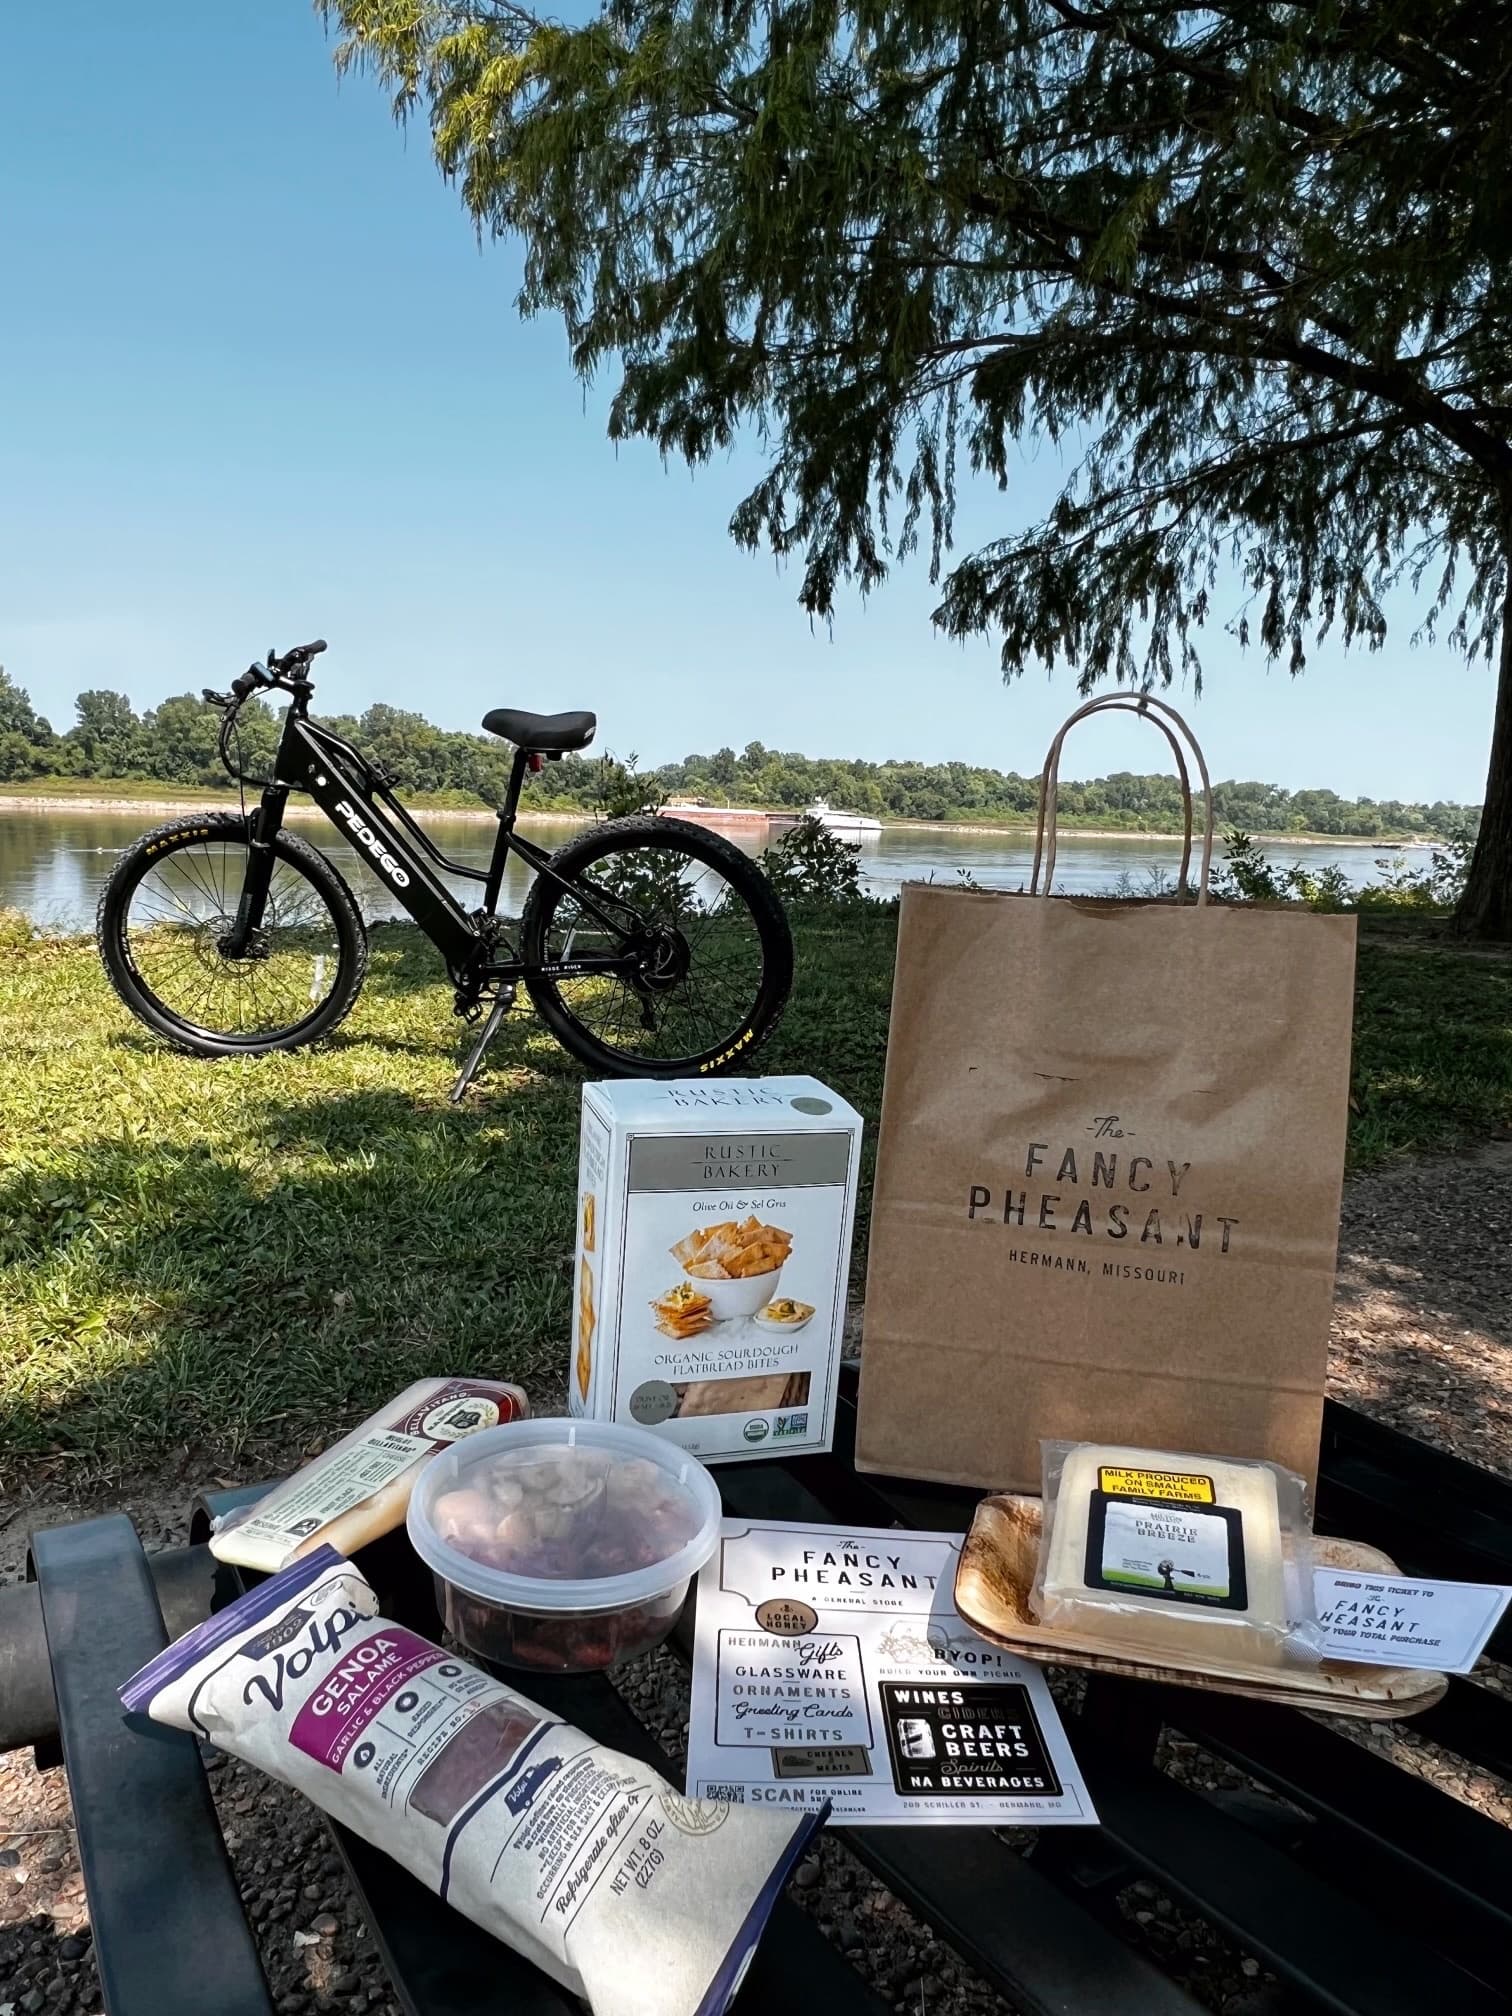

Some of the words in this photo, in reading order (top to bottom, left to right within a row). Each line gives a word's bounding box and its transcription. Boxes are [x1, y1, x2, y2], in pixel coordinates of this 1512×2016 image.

[145, 829, 209, 856] MAXXIS
[334, 800, 410, 888] PEDEGO
[700, 1028, 754, 1073] MAXXIS
[668, 1087, 777, 1097] RUSTIC
[674, 1097, 784, 1107] BAKERY
[1094, 1115, 1124, 1138] The
[705, 1144, 781, 1160] RUSTIC
[703, 1163, 780, 1179] BAKERY
[1025, 1143, 1191, 1197] FANCY
[692, 1201, 717, 1212] Olive
[719, 1200, 734, 1211] Oil
[736, 1200, 748, 1210] &
[751, 1199, 764, 1209] Sel
[766, 1198, 787, 1209] Gris
[967, 1185, 1240, 1253] PHEASANT
[1009, 1249, 1091, 1275] HERMANN,
[1102, 1263, 1185, 1285] MISSOURI
[654, 1351, 714, 1365] ORGANIC
[717, 1344, 799, 1361] SOURDOUGH
[673, 1361, 743, 1376] FLATBREAD
[747, 1358, 780, 1370] BITES
[1105, 1469, 1134, 1478] MILK
[1138, 1473, 1207, 1486] PRODUCED
[1146, 1481, 1188, 1491] SMALL
[1112, 1485, 1154, 1495] FAMILY
[1159, 1490, 1202, 1500] FARMS
[1135, 1520, 1198, 1536] PRAIRIE
[1137, 1529, 1197, 1544] BREEZE
[839, 1541, 860, 1550] The
[803, 1551, 901, 1570] FANCY
[771, 1567, 937, 1590] PHEASANT
[1388, 1587, 1419, 1596] TICKET
[824, 1596, 866, 1606] GENERAL
[872, 1599, 904, 1607] STORE
[1335, 1600, 1405, 1617] FANCY
[765, 1620, 807, 1630] HONEY
[766, 1612, 805, 1622] LOCAL
[1320, 1611, 1420, 1633] HEASANT
[1333, 1628, 1357, 1637] YOUR
[1360, 1631, 1386, 1641] TOTAL
[1390, 1634, 1441, 1647] PURCHASE
[243, 1600, 374, 1712] Volpi
[728, 1637, 801, 1649] HERMANN
[794, 1642, 844, 1665] Gifts
[934, 1649, 1002, 1667] BYOP!
[312, 1637, 399, 1716] GENOA
[735, 1666, 847, 1681] GLASSWARE
[983, 1671, 1022, 1679] PICNIC
[337, 1651, 403, 1716] SALAME
[733, 1685, 851, 1699] ORNAMENTS
[893, 1690, 964, 1705] WINES
[332, 1715, 365, 1764] GARLIC
[363, 1707, 374, 1717] &
[372, 1672, 407, 1705] BLACK
[408, 1651, 445, 1673] PEPPER
[732, 1701, 800, 1721] Greeting
[803, 1703, 853, 1719] Cards
[744, 1727, 843, 1741] T-SHIRTS
[941, 1723, 1022, 1740] CRAFT
[417, 1730, 449, 1766] RECIPE
[945, 1741, 1029, 1758] BEERS
[373, 1758, 385, 1772] ALL
[376, 1752, 399, 1785] NATURAL
[940, 1758, 1004, 1775] Spirits
[911, 1776, 933, 1787] NA
[941, 1776, 1044, 1788] BEVERAGES
[507, 1781, 528, 1802] Volpi
[752, 1788, 805, 1802] SCAN
[564, 1820, 577, 1836] FOR
[573, 1796, 593, 1821] THOSE
[538, 1845, 549, 1860] NO
[547, 1805, 577, 1846] ARTIFICIAL
[536, 1851, 567, 1900] OCCURRING
[564, 1839, 574, 1852] IN
[569, 1826, 583, 1842] SEA
[580, 1806, 596, 1826] SALT
[594, 1799, 601, 1808] &
[556, 1834, 607, 1914] Refrigerate
[606, 1804, 630, 1837] after
[610, 1867, 631, 1897] NET
[624, 1849, 645, 1872] WT.
[639, 1837, 651, 1850] 8
[634, 1848, 666, 1889] (227G)
